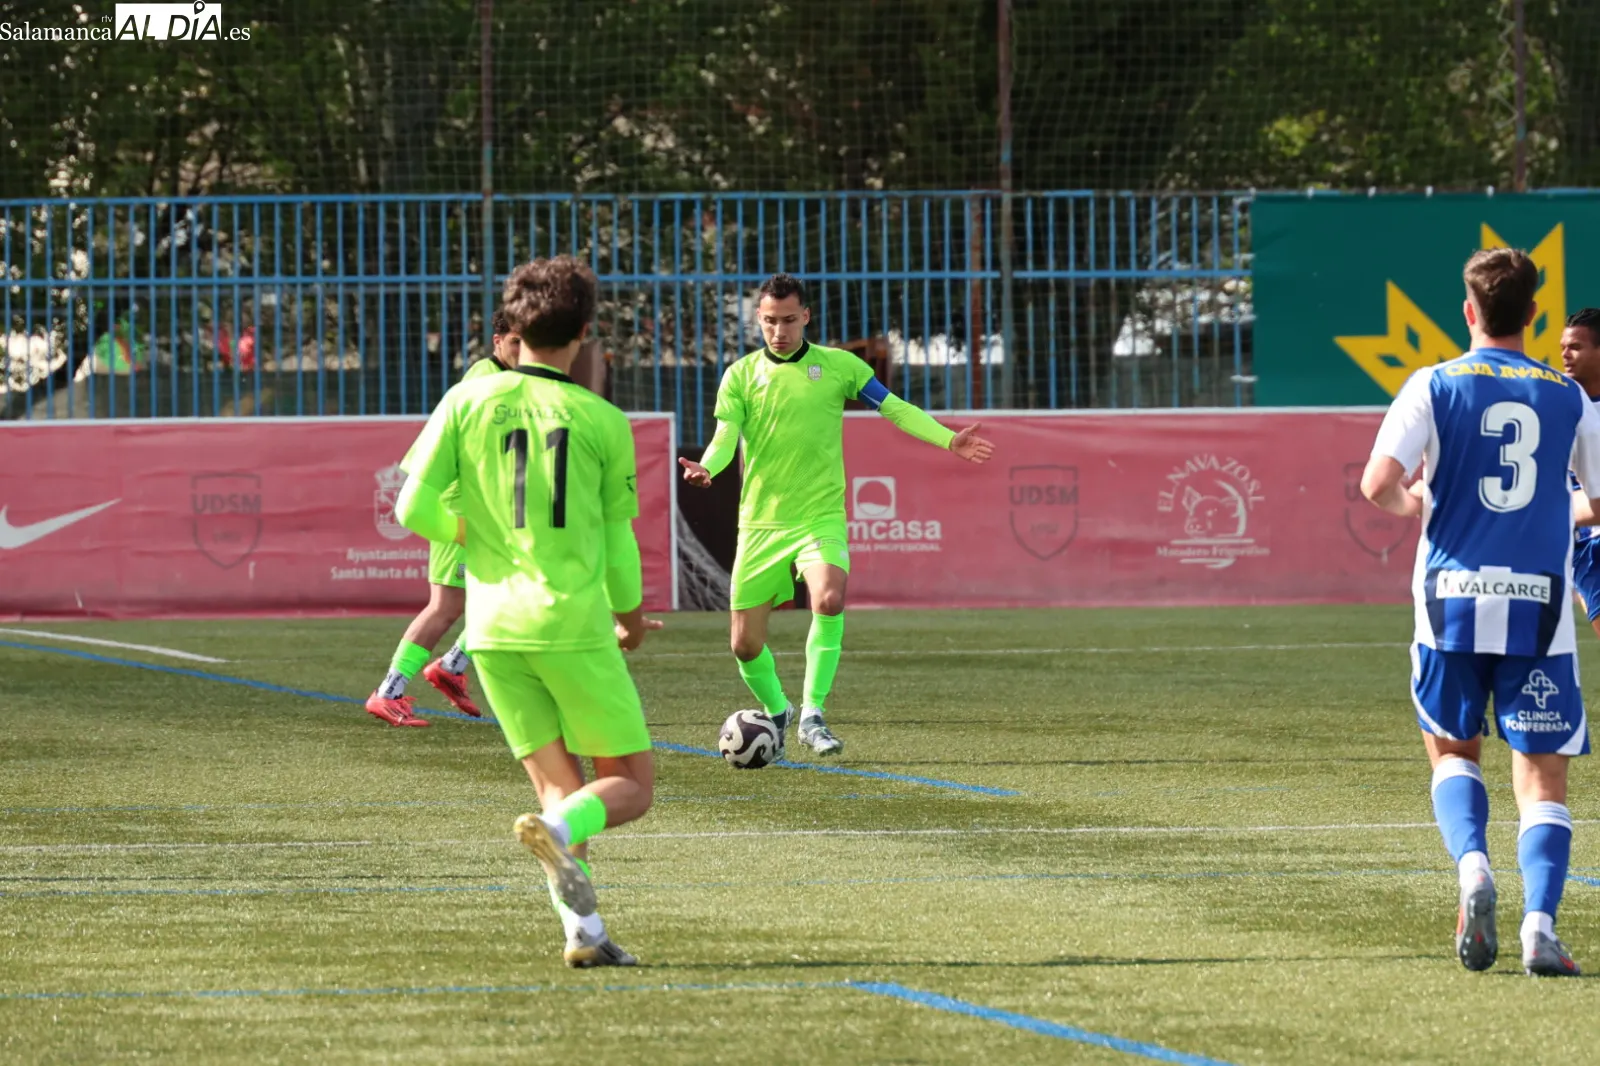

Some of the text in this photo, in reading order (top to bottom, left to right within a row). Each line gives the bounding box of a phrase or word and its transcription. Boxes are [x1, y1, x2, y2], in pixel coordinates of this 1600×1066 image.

[1478, 401, 1540, 513] 3
[501, 427, 569, 529] 11
[191, 493, 262, 514] UDSM
[1009, 485, 1078, 505] UDSM
[848, 520, 942, 540] mcasa
[331, 566, 365, 580] Santa
[367, 566, 402, 579] Marta
[404, 565, 419, 579] de
[1459, 581, 1549, 600] VALCARCE
